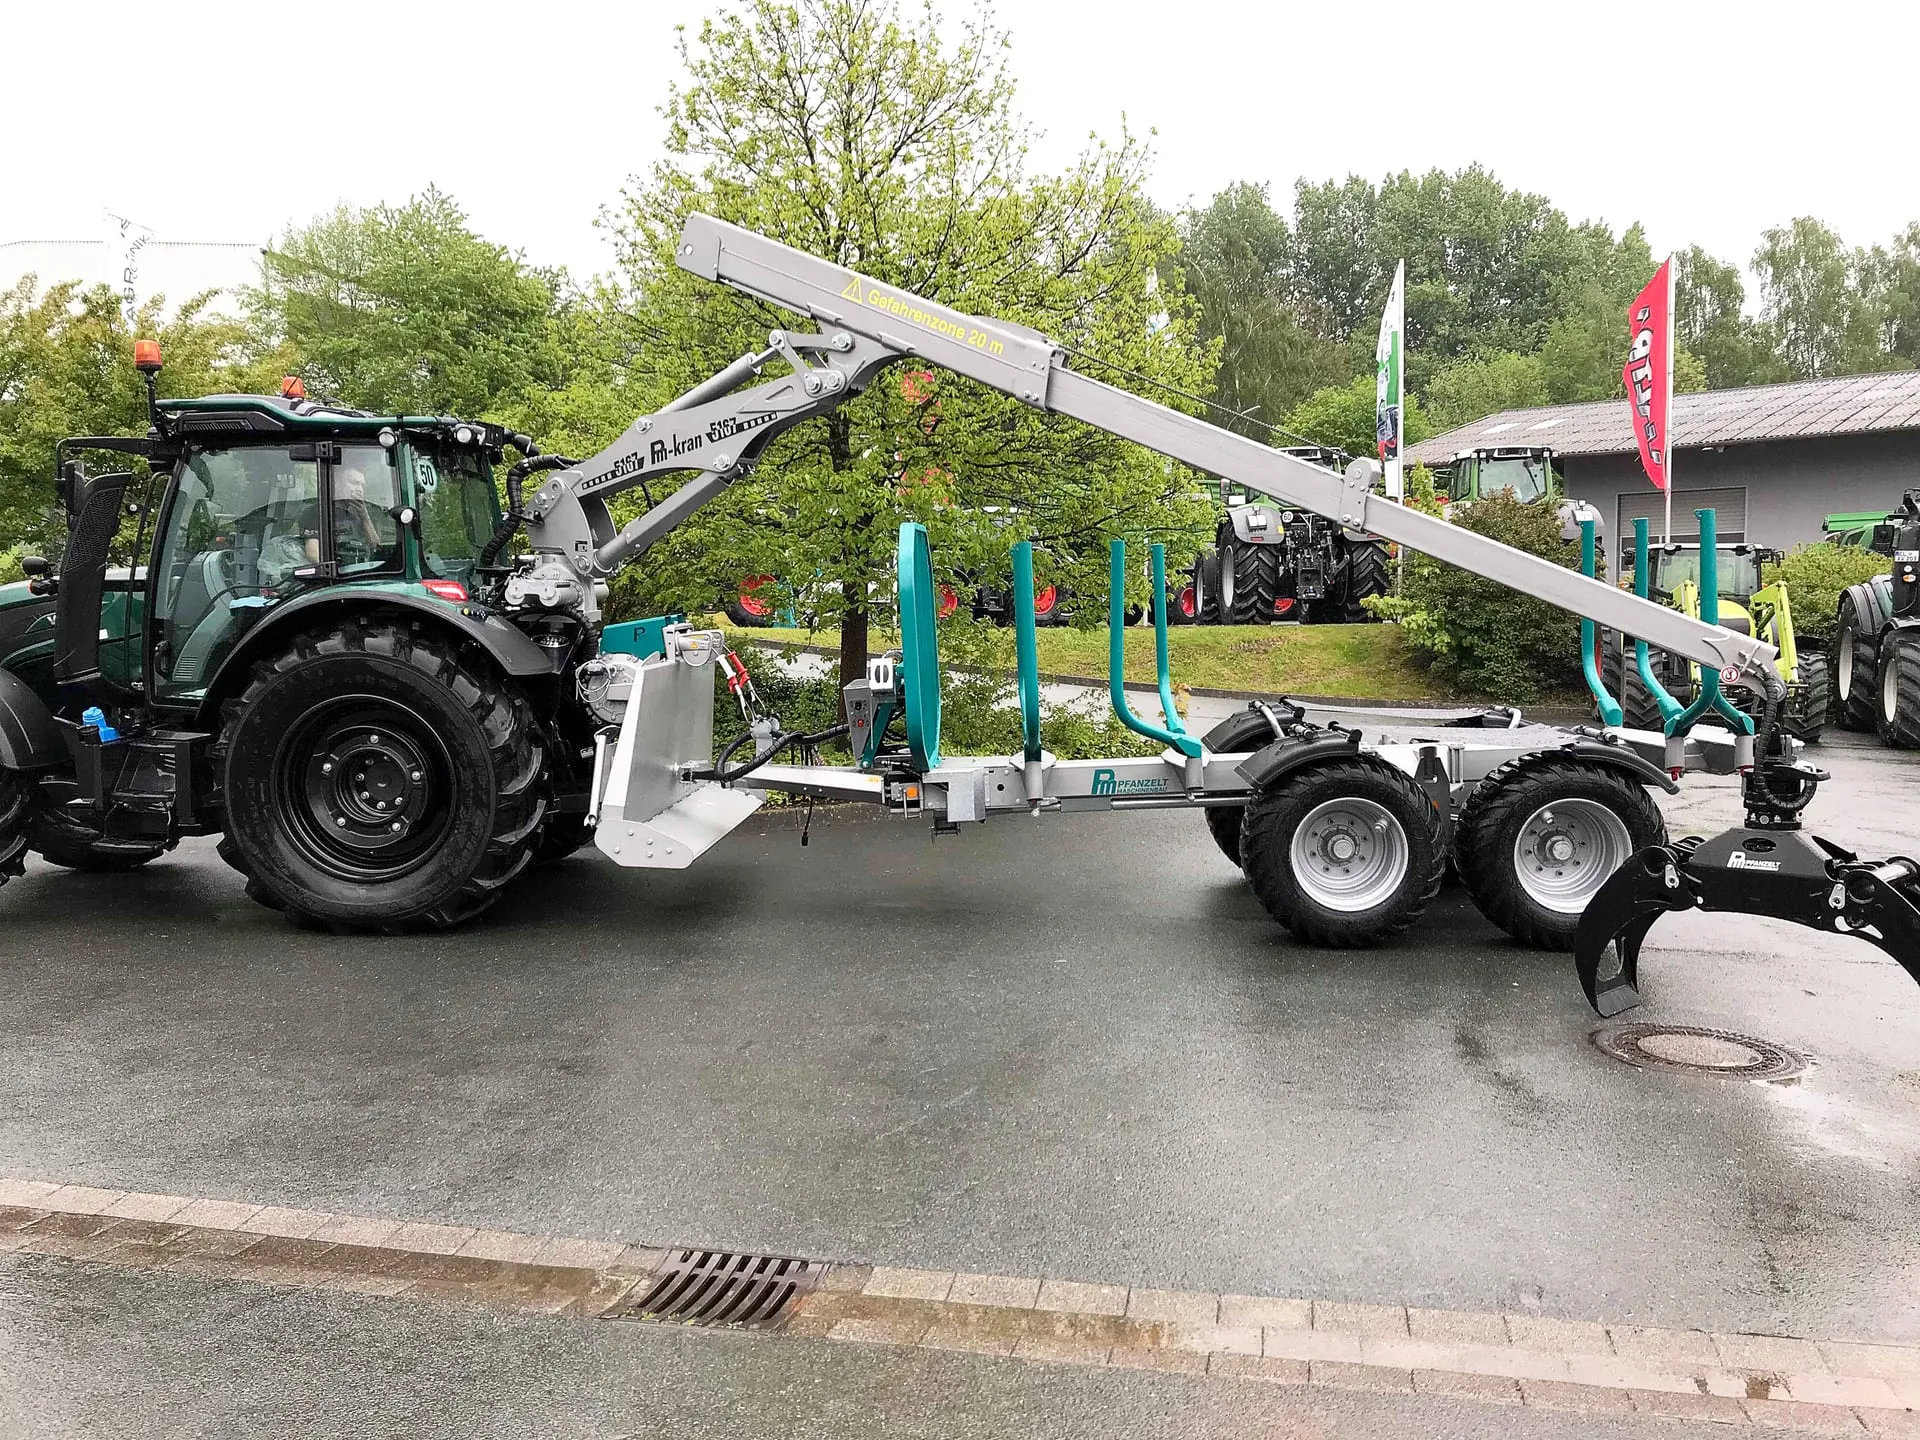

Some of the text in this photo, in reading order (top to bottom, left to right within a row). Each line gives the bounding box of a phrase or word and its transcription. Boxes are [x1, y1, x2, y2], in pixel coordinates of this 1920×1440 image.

[868, 289, 1004, 355] Gefahrenzone 20 m
[710, 417, 737, 440] 5167
[420, 464, 434, 487] 50
[613, 452, 640, 476] 5167
[1117, 779, 1168, 788] PFANZELT
